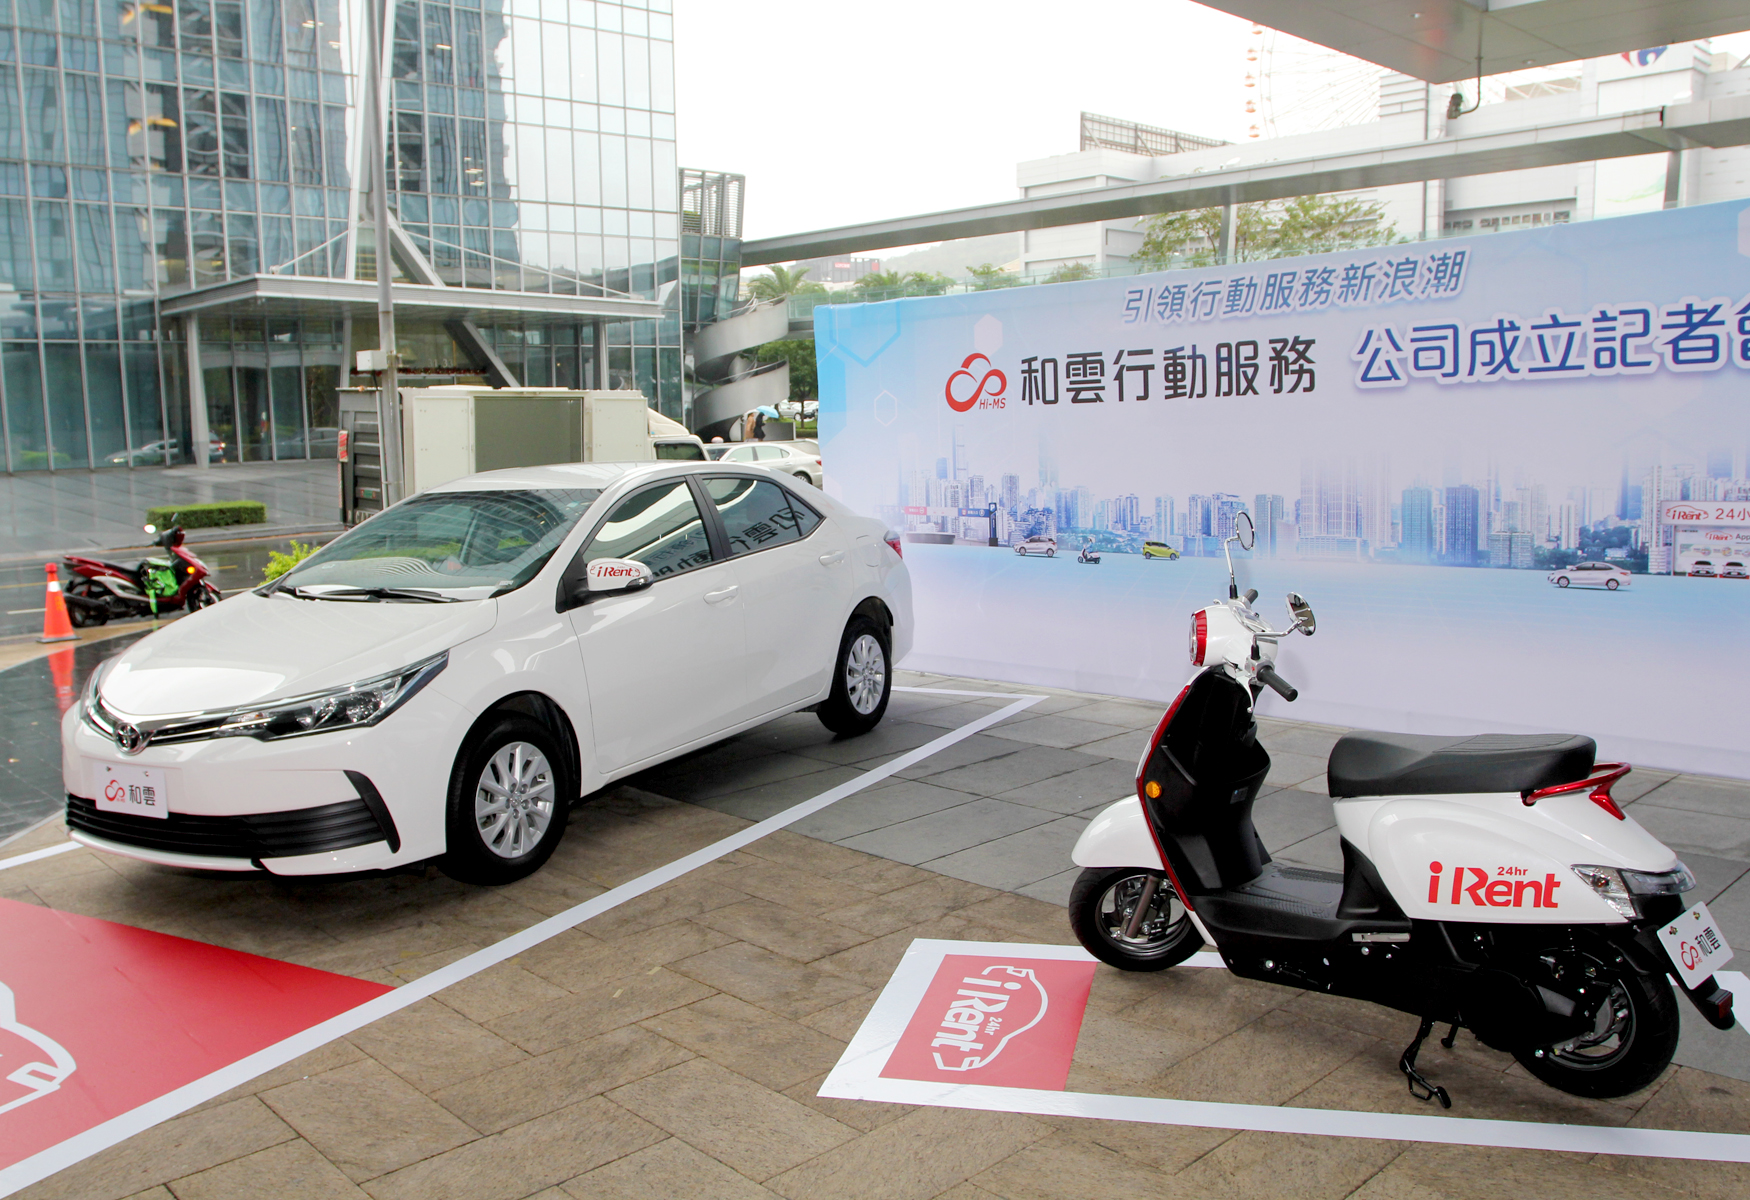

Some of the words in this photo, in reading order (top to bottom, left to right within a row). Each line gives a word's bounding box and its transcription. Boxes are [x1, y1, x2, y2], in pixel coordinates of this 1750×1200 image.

[1123, 250, 1467, 324] 引領行動服務新浪潮
[1356, 302, 1750, 383] 公司成立記者
[1020, 336, 1317, 406] 和雲行動服務
[978, 397, 1007, 410] Hi-MS
[128, 784, 156, 806] 和雲
[1497, 866, 1528, 876] 24hr
[1694, 926, 1722, 957] 和雲
[984, 1016, 1003, 1036] 24hr
